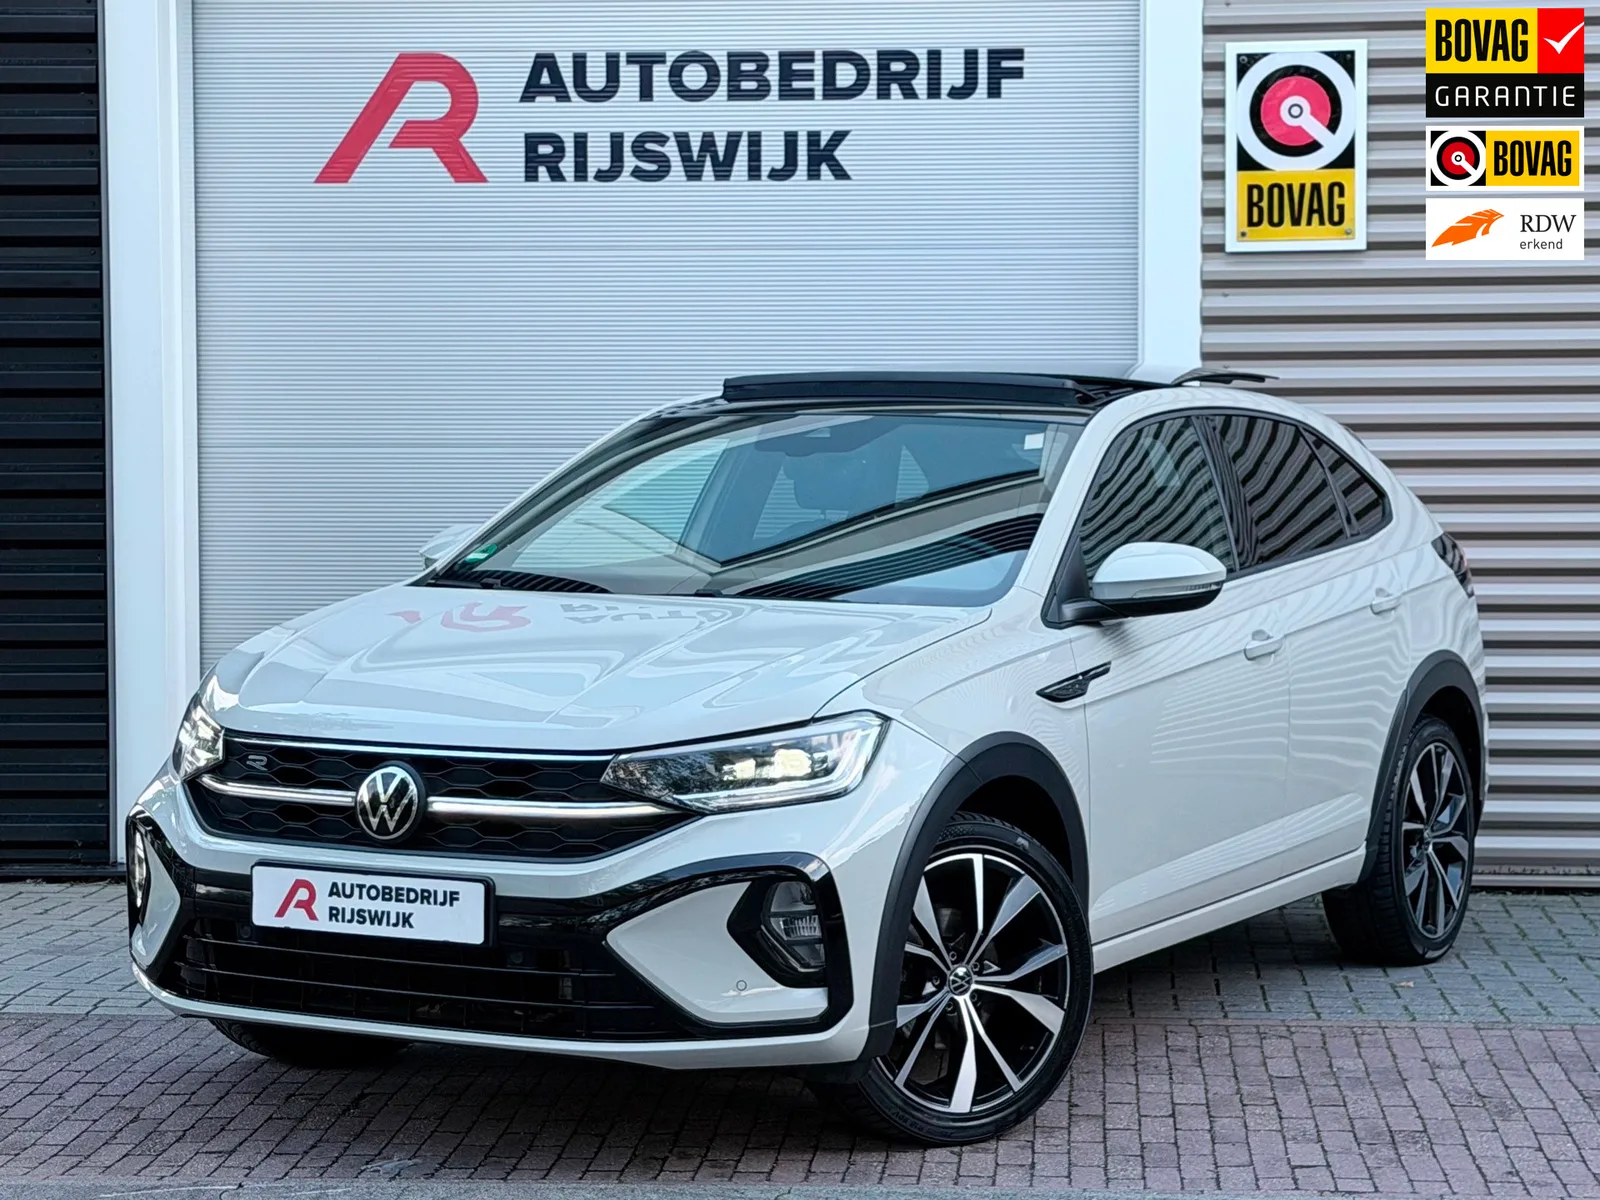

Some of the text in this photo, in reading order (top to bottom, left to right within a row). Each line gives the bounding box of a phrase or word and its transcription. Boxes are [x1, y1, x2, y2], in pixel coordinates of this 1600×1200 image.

[519, 48, 1025, 103] AUTOBEDRIJF
[524, 130, 852, 183] RIJSWIJK
[1246, 181, 1346, 228] BOVAG
[328, 881, 460, 907] AUTOBEDRIJF
[328, 906, 414, 929] RIJSWIJK
